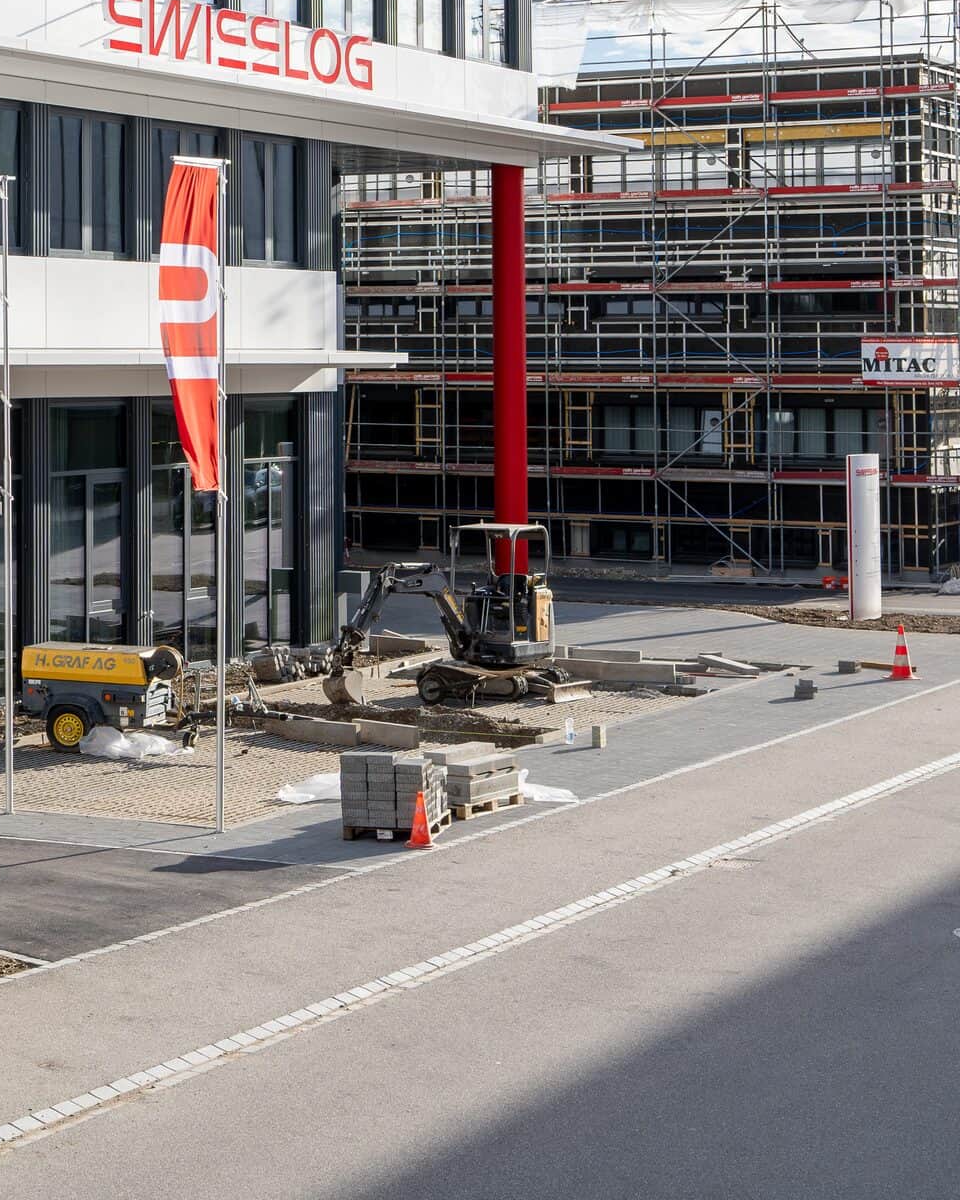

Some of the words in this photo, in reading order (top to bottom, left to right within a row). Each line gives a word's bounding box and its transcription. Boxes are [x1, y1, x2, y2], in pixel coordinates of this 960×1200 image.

[863, 357, 936, 373] MITAC
[52, 654, 90, 670] GRAF
[92, 657, 117, 671] AG
